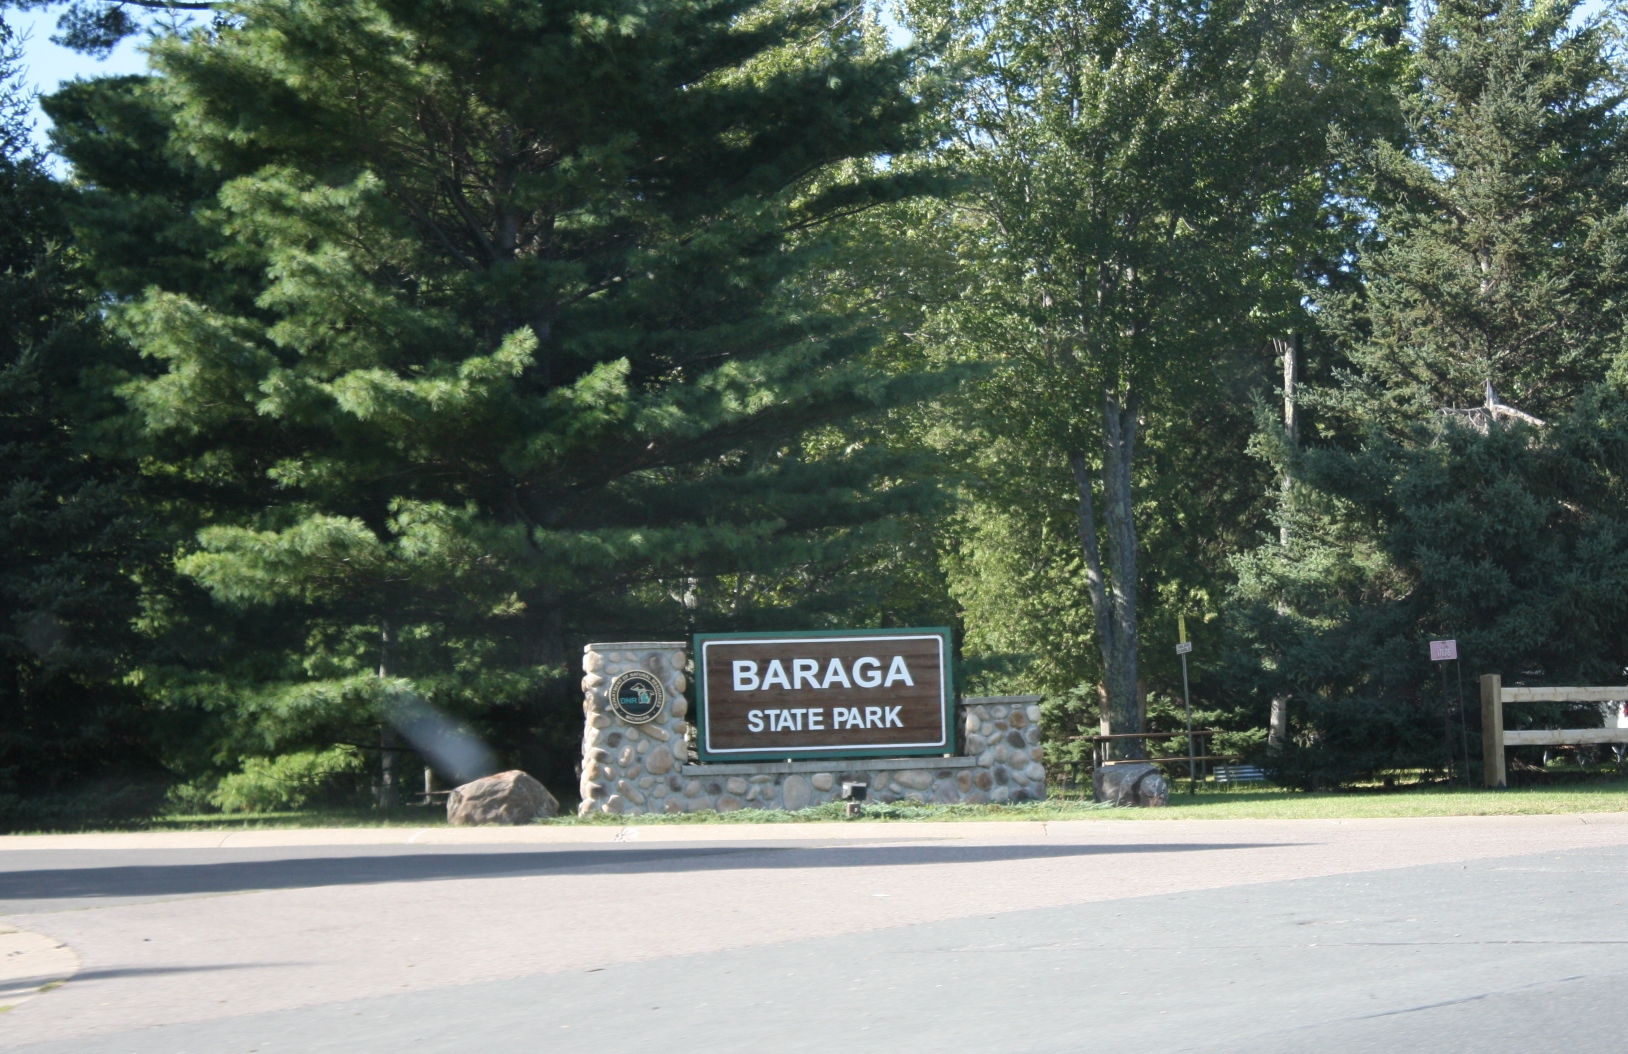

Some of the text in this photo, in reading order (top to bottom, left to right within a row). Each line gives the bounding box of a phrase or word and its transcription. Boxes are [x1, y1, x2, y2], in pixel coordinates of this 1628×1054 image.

[611, 678, 622, 709] DEPARTMENT
[629, 672, 651, 680] NATURAL
[651, 679, 662, 707] RESOURCES
[732, 656, 914, 692] BARAGA
[747, 706, 904, 732] STATE PARK
